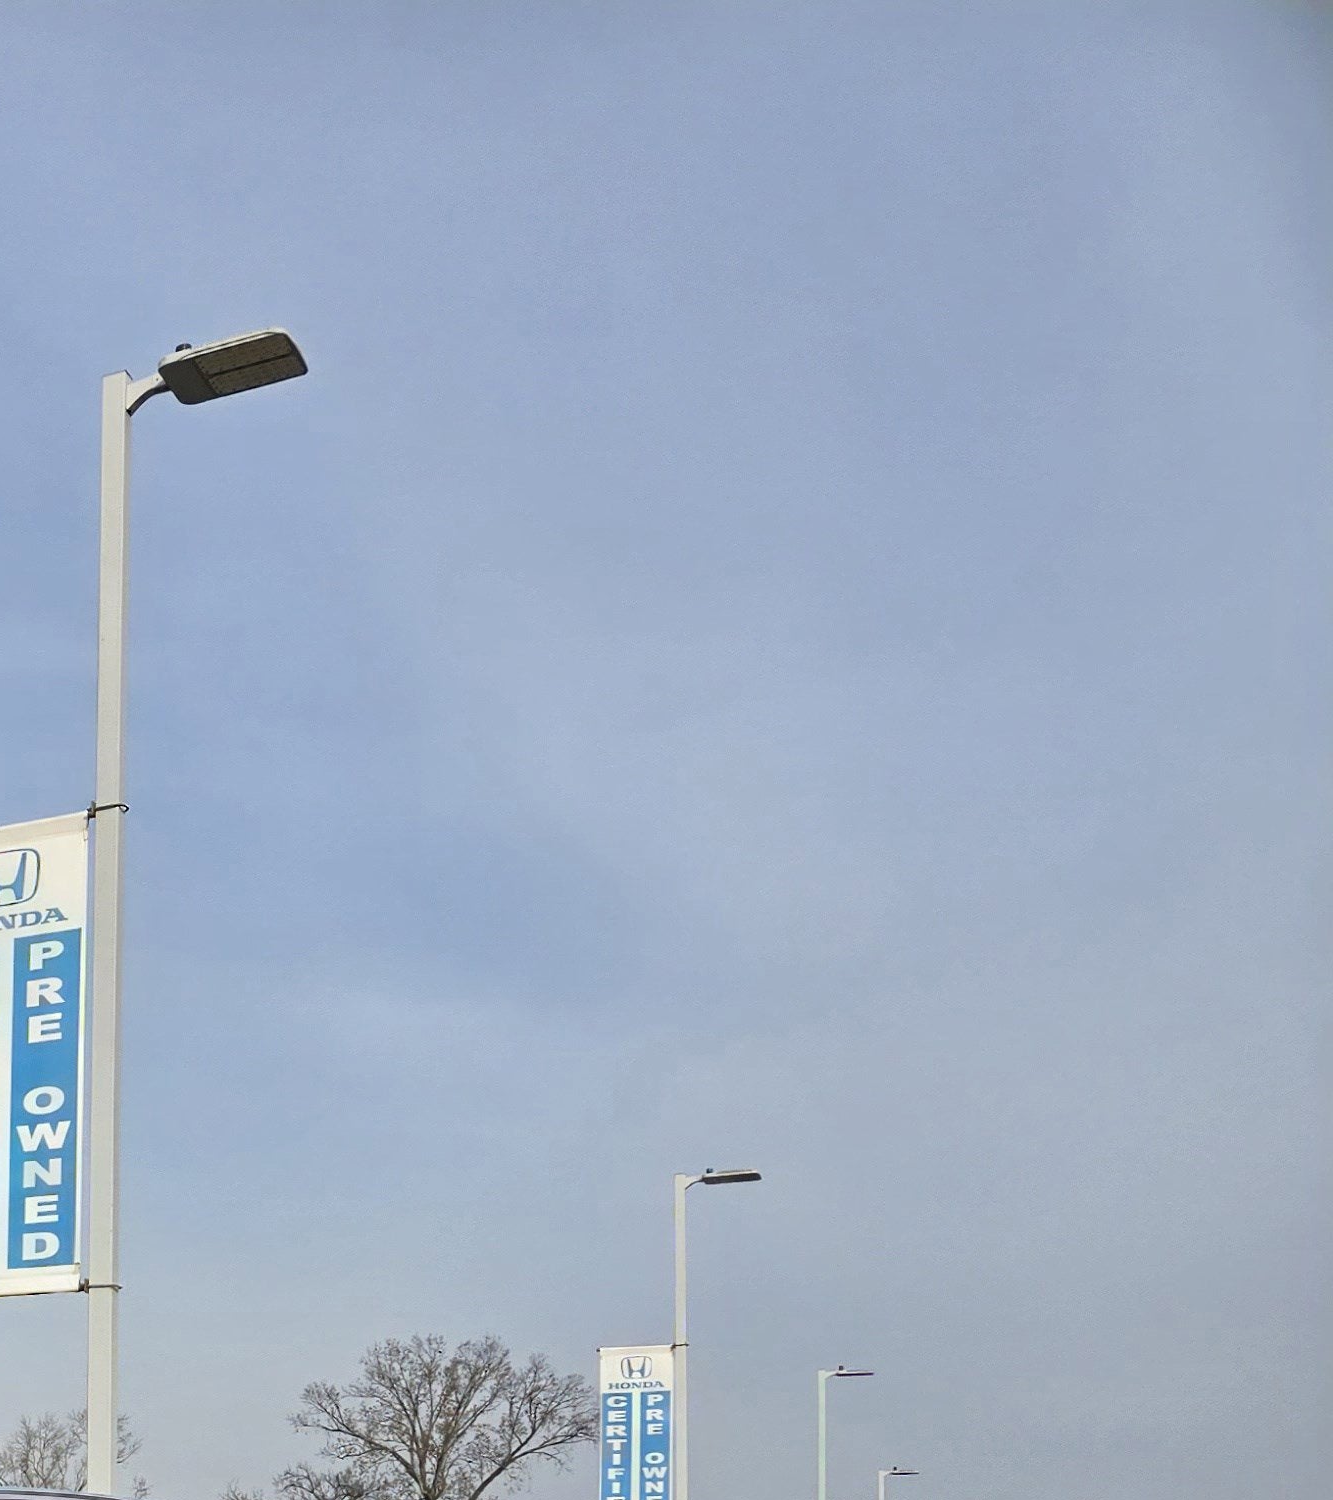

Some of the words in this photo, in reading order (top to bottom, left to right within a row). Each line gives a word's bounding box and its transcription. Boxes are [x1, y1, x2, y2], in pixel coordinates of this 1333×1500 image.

[25, 939, 67, 1045] PRE
[15, 1083, 72, 1262] OWNED
[607, 1380, 665, 1390] HONDA
[645, 1394, 665, 1436] PRE
